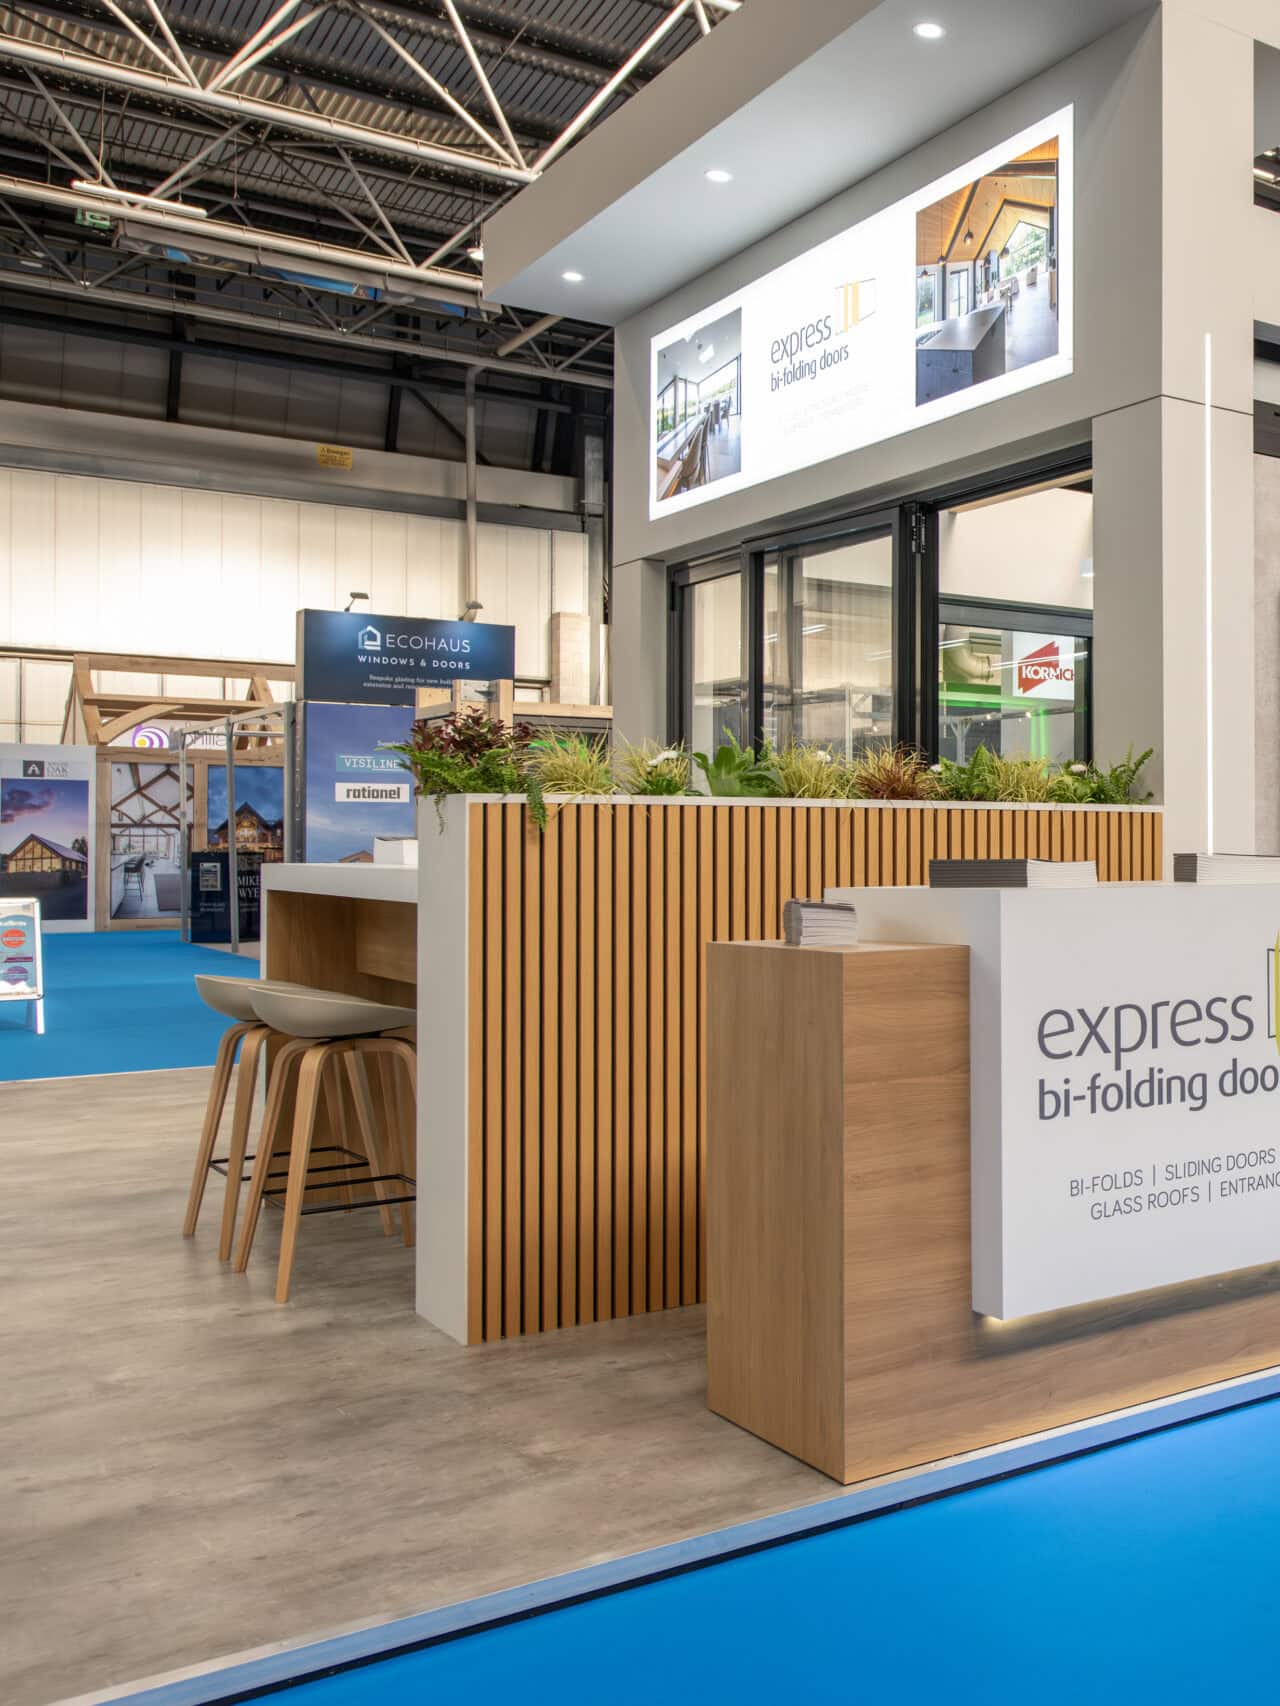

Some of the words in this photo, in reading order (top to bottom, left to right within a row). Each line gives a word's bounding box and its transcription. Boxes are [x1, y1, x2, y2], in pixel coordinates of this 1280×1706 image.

[771, 315, 832, 364] express
[771, 360, 817, 391] bi-folding
[820, 345, 849, 370] doors
[358, 655, 415, 666] WINDOWS
[420, 659, 427, 667] &
[432, 660, 471, 670] DOORS
[386, 634, 471, 653] ECOHAUS
[1038, 994, 1255, 1071] express
[1038, 1067, 1208, 1120] bi-folding
[1070, 1170, 1143, 1197] BI-FOLDS
[1165, 1157, 1222, 1181] SLIDING
[1226, 1148, 1276, 1170] DOORS
[1090, 1196, 1143, 1220] GLASS
[1147, 1186, 1200, 1210] ROOFS
